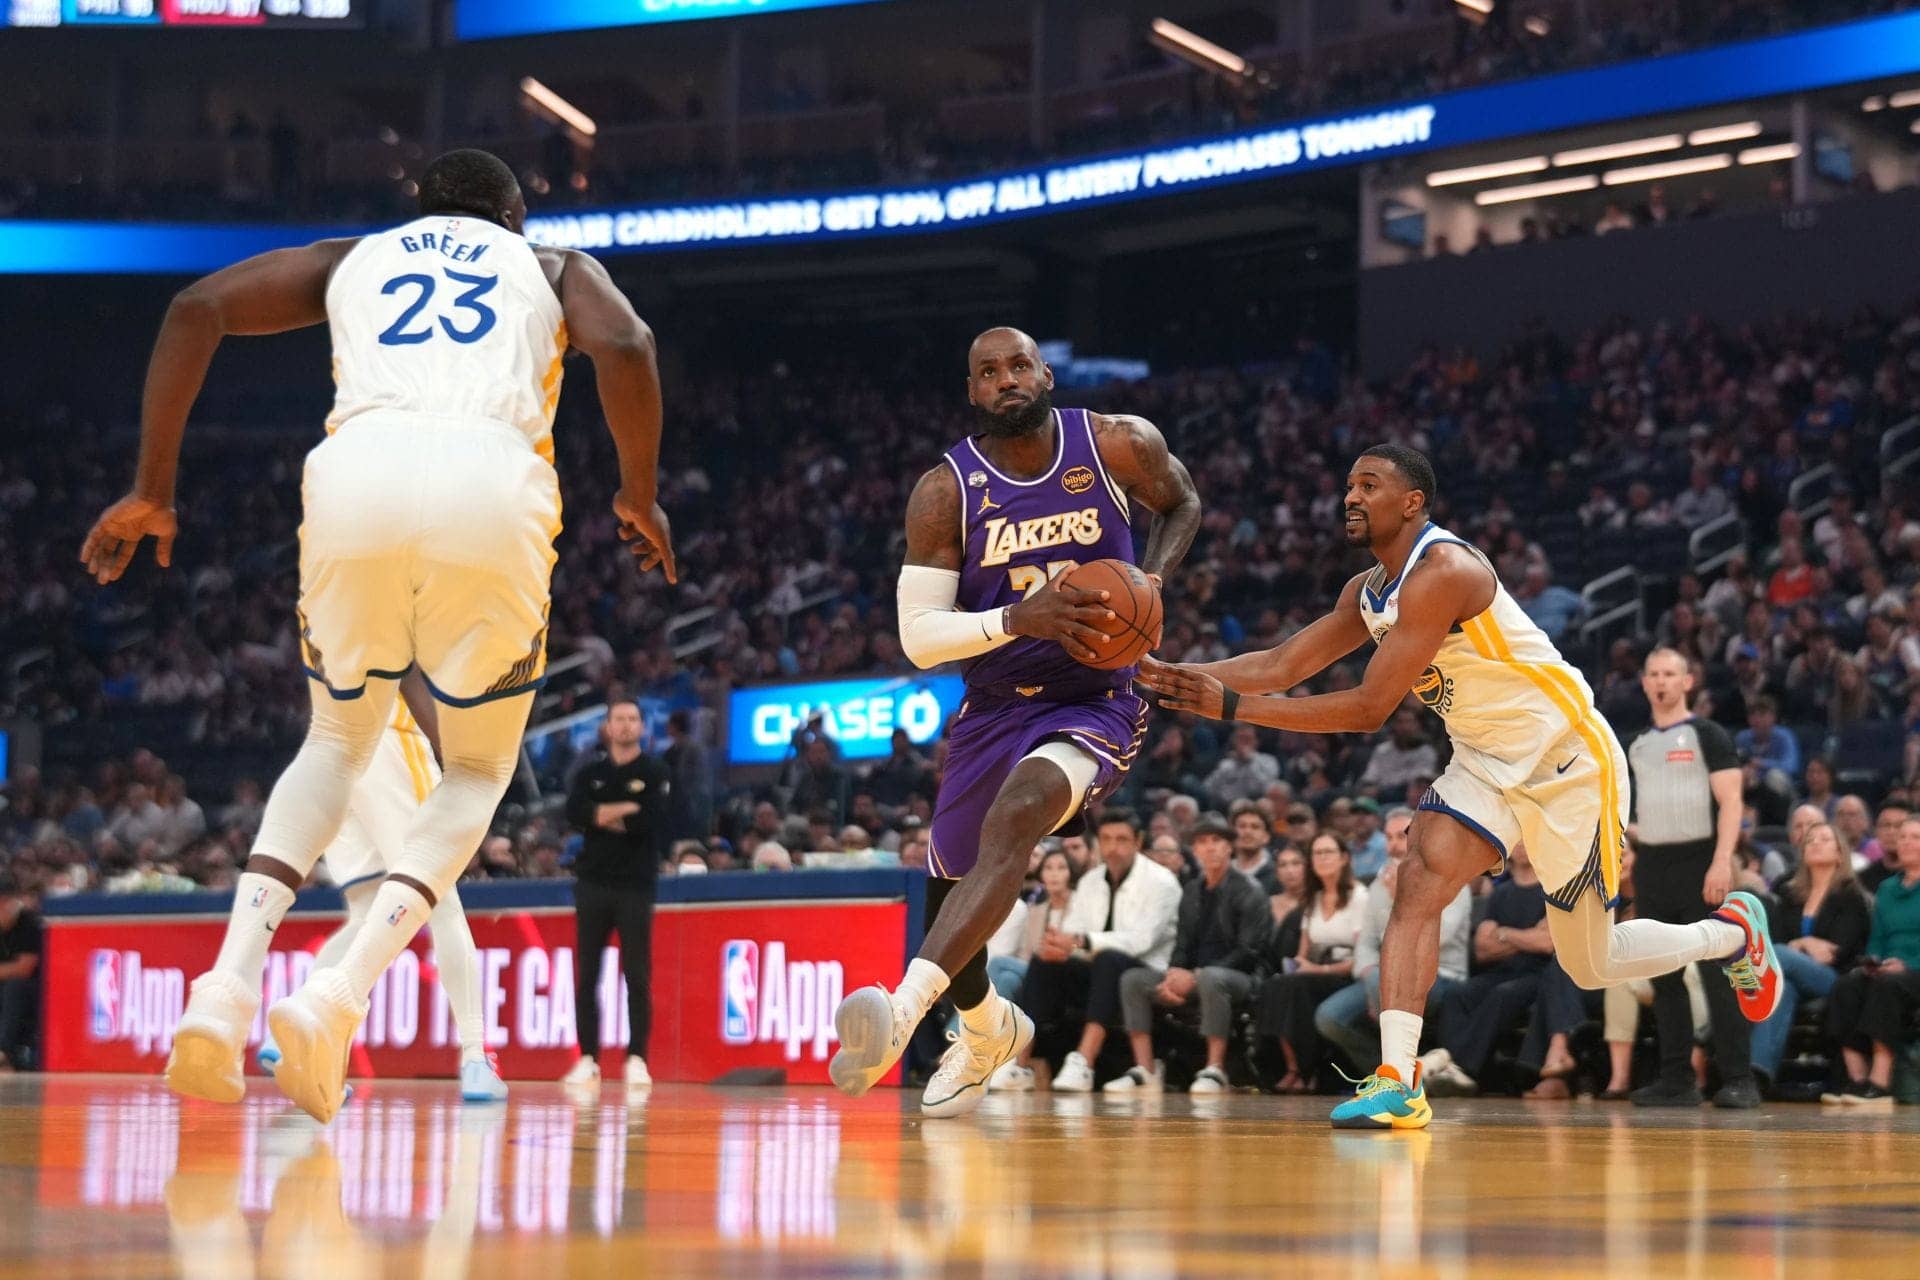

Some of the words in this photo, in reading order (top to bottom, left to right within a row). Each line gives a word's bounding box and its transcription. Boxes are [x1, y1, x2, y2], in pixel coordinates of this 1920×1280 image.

[616, 201, 820, 245] CARDHOLDERS
[823, 196, 880, 230] GET
[946, 182, 995, 220] OFF
[996, 176, 1045, 212] ALL
[1143, 130, 1300, 187] PURCHASES
[1301, 106, 1433, 160] TONIGHT
[401, 232, 490, 263] GREEN
[378, 267, 498, 345] 23
[1064, 473, 1092, 486] bibigo
[980, 507, 1102, 568] LAKERS
[752, 697, 894, 746] CHASE
[1435, 678, 1454, 715] RIORS
[121, 949, 185, 1057] App
[758, 941, 844, 1060] App
